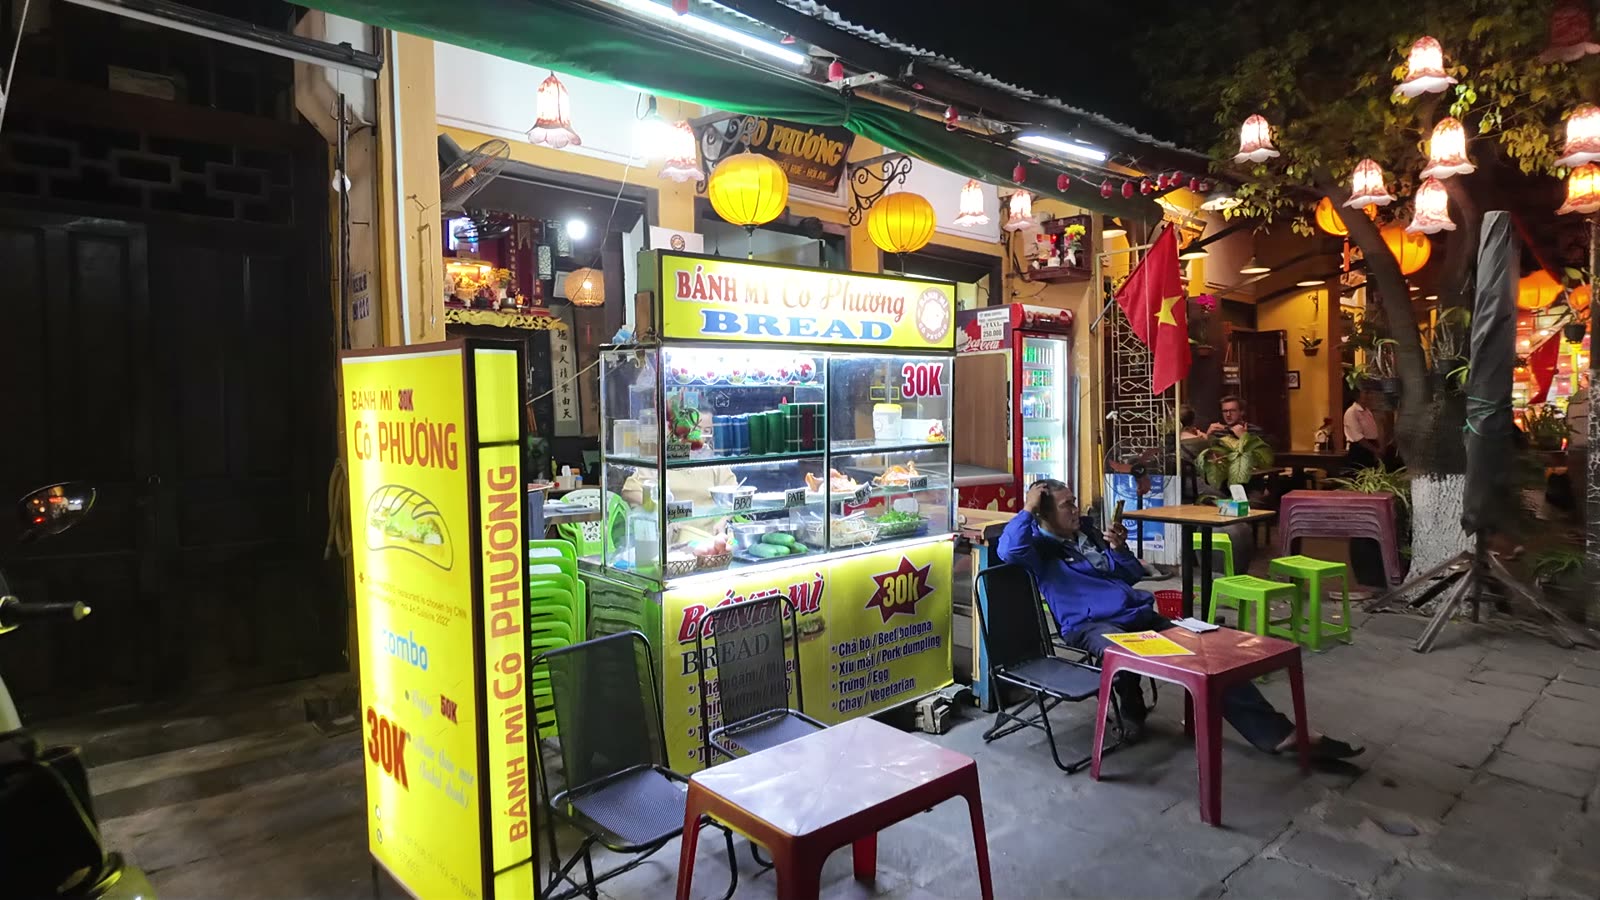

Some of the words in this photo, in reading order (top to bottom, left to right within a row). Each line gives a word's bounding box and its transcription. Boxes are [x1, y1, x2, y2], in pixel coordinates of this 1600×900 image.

[767, 126, 844, 167] PHƯƠNG
[675, 265, 738, 302] BÁNH
[819, 278, 906, 323] Phương
[700, 310, 893, 341] BREAD
[379, 386, 393, 412] MÌ
[398, 389, 414, 412] 30K
[902, 362, 944, 398] 30K
[378, 417, 459, 471] PHƯƠNG
[733, 497, 752, 511] BBQ
[485, 465, 522, 638] PHƯƠNG
[677, 588, 782, 645] BÁNH
[783, 571, 825, 620] MÌ
[878, 629, 897, 644] Beef
[899, 621, 932, 638] bologna
[882, 646, 901, 662] Pork
[902, 635, 942, 656] dumpling
[680, 631, 771, 676] BREAD
[493, 652, 523, 700] Cô
[839, 695, 863, 712] Chay
[870, 678, 915, 700] Vegetarian
[873, 669, 889, 683] Egg
[500, 704, 525, 745] MÌ
[367, 705, 409, 792] 30K
[503, 756, 529, 842] BÁNH
